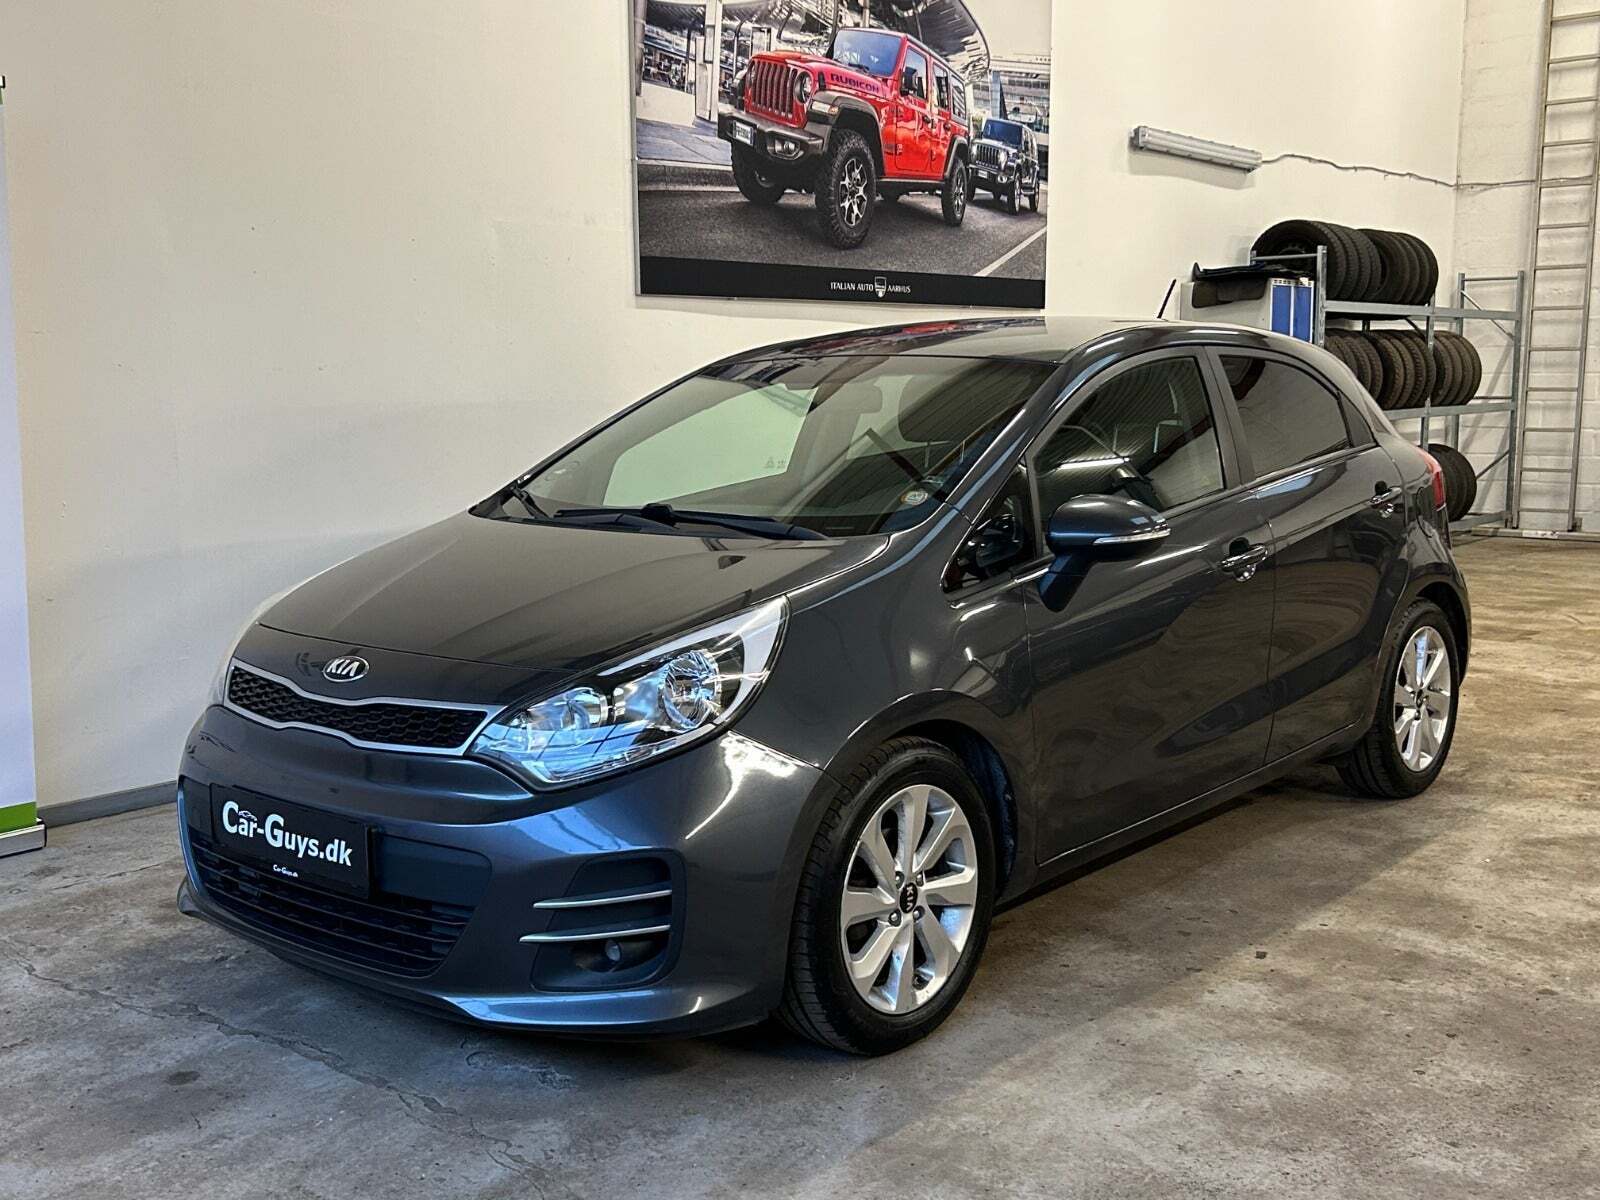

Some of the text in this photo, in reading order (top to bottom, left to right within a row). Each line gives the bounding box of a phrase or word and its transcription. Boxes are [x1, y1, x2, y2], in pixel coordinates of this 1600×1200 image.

[830, 73, 880, 93] RUBICON
[830, 281, 912, 294] ITALIAN AUTO AARHUS
[326, 659, 361, 677] KIA
[222, 800, 353, 867] Car-Guys.dk
[906, 886, 914, 911] KIA
